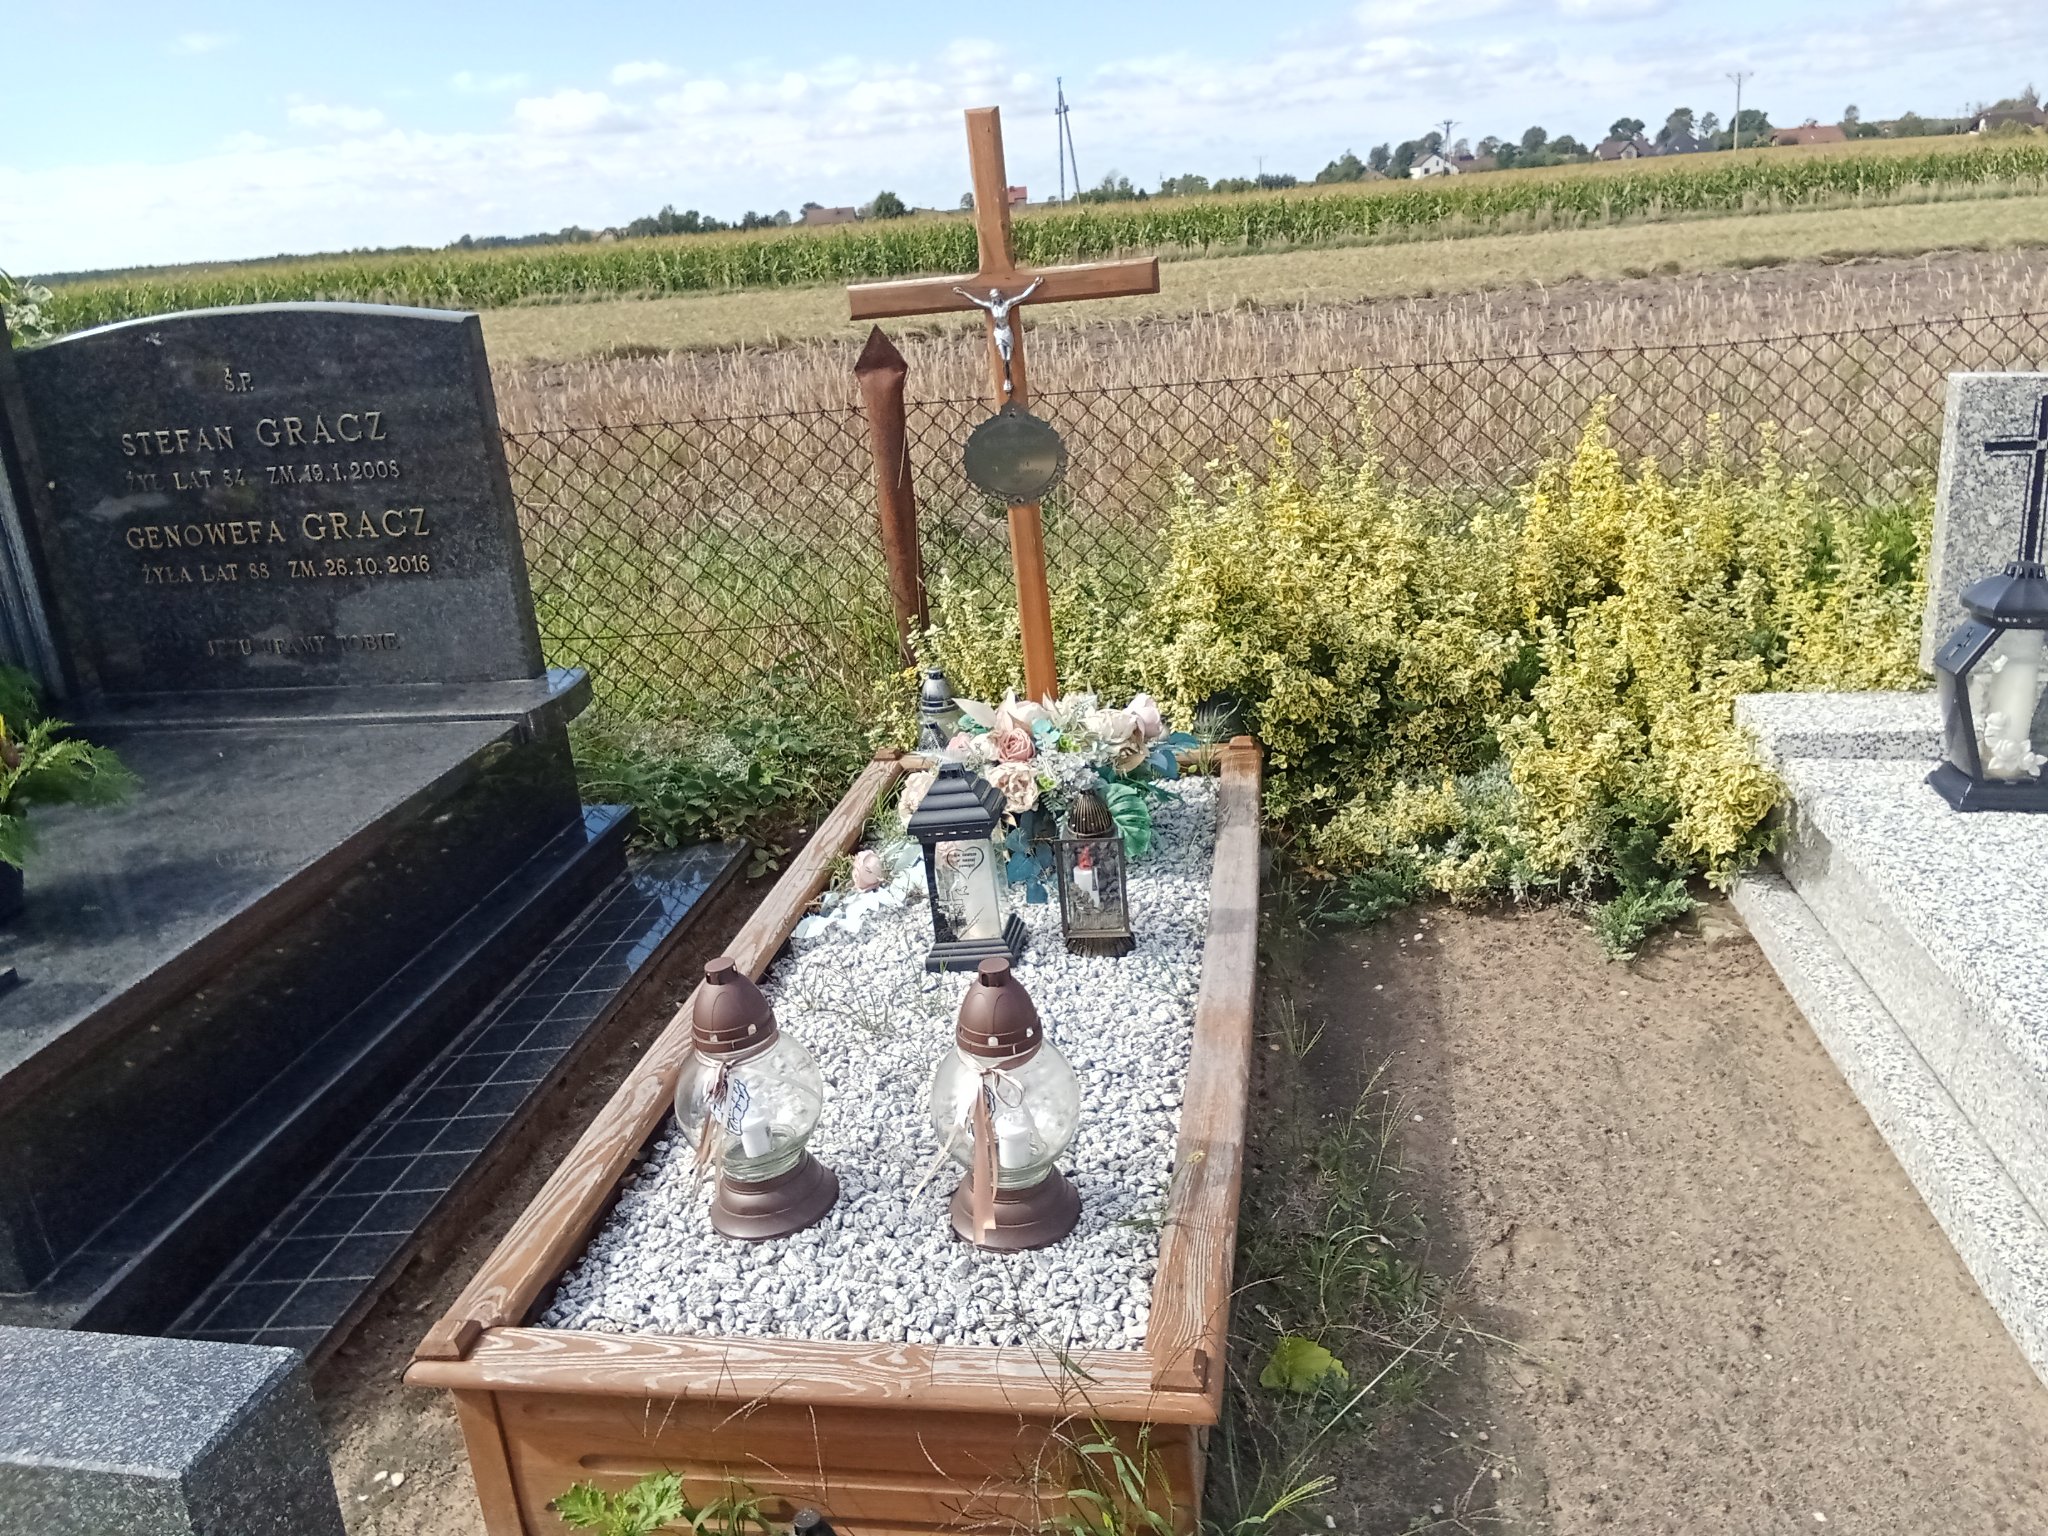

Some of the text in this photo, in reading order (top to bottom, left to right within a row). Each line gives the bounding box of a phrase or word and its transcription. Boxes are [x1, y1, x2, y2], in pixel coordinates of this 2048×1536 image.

[121, 411, 387, 456] STEFAN GRACZ
[172, 469, 212, 490] LAT
[126, 508, 431, 549] GENOWEFA GRACZ
[200, 563, 238, 582] LAT
[249, 562, 270, 579] 88
